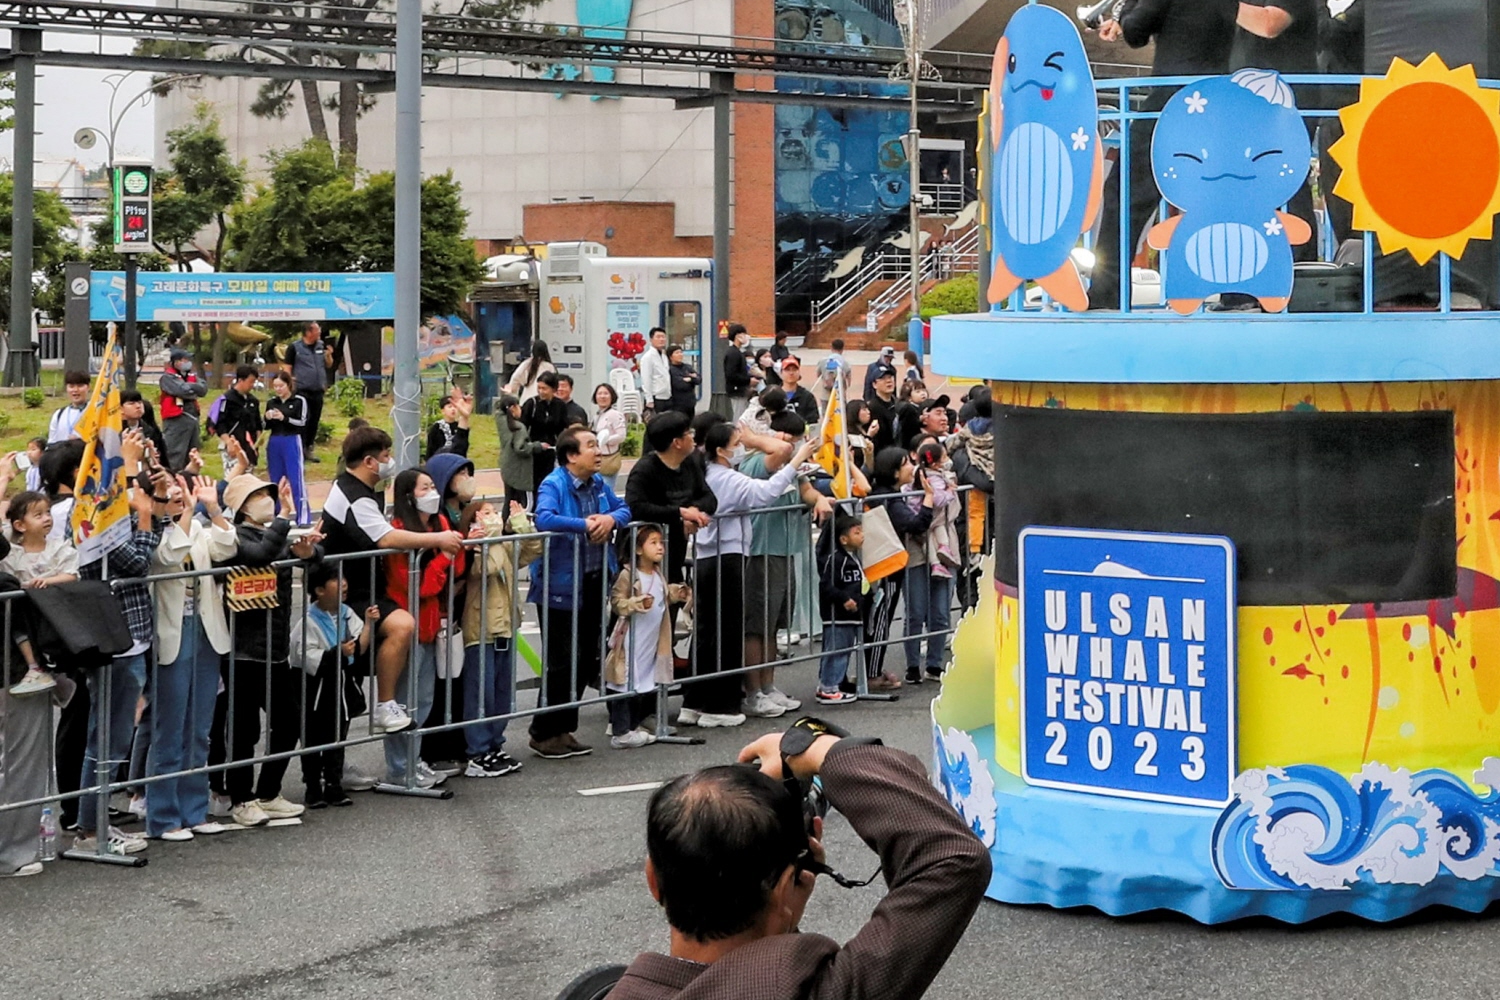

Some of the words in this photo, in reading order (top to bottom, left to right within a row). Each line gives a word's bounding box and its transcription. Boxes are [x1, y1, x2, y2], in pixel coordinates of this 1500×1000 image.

[151, 280, 224, 293] 고래문화특구
[227, 280, 268, 293] 모바일
[273, 280, 300, 293] 예매
[304, 280, 331, 293] 안내
[233, 578, 277, 595] 접근금지
[1044, 589, 1206, 642] ULSAN
[1044, 632, 1206, 688] WHALE
[1045, 676, 1207, 734] FESTIVAL
[1044, 721, 1206, 782] 2023
